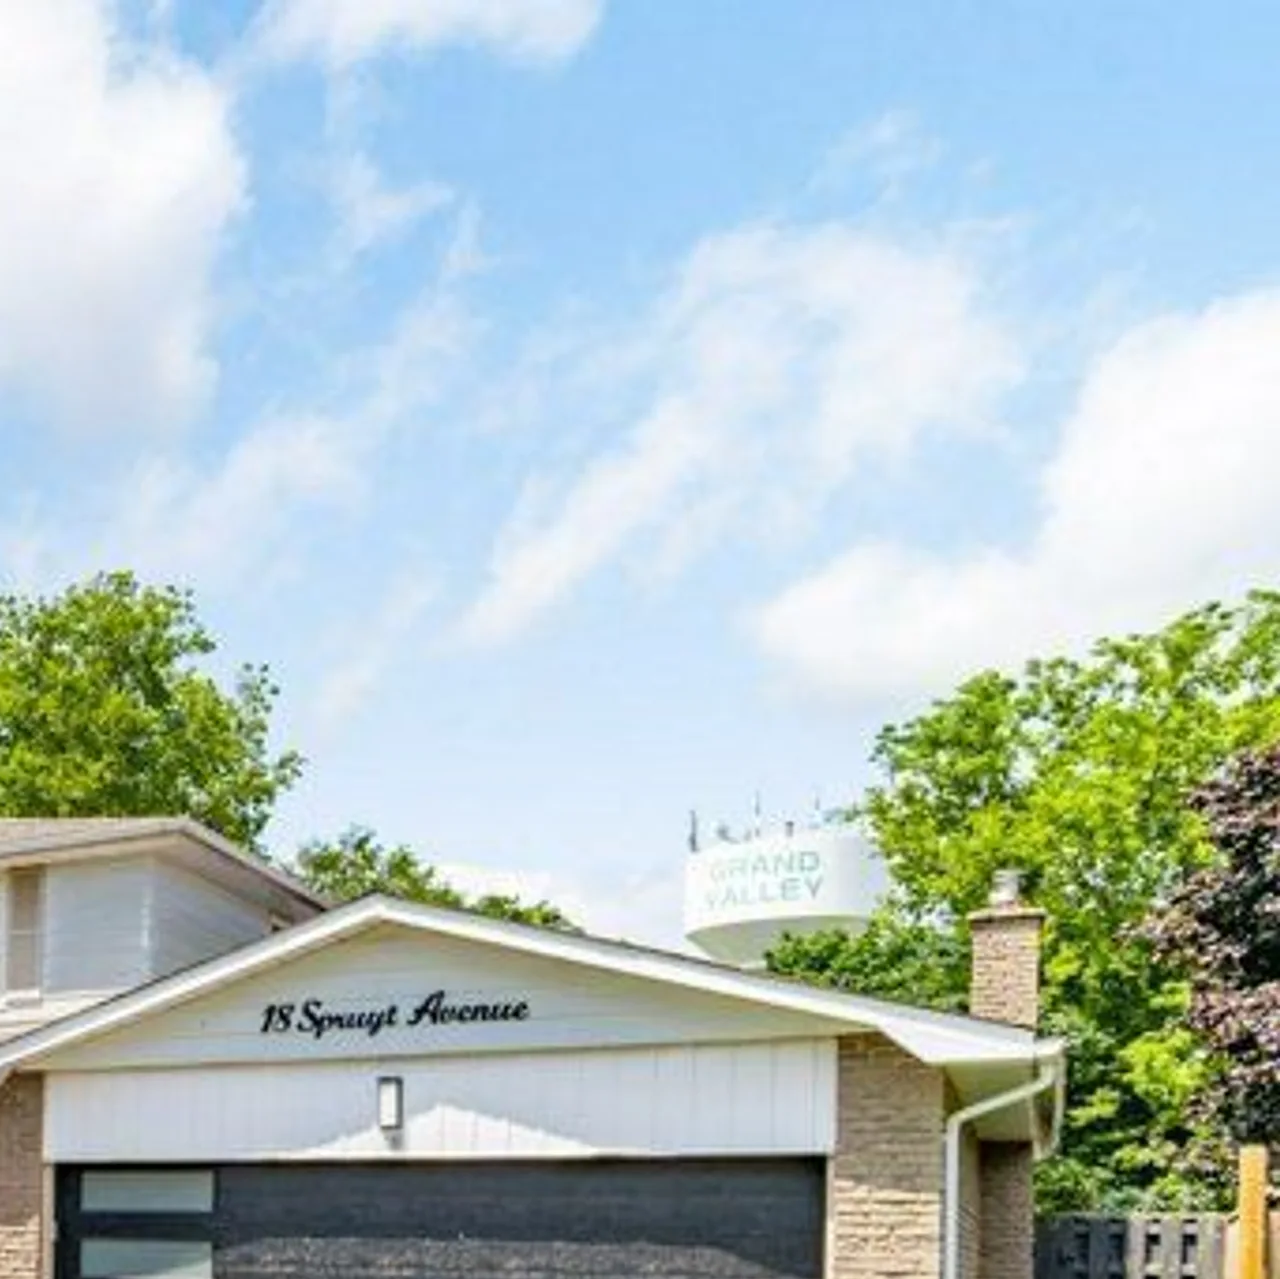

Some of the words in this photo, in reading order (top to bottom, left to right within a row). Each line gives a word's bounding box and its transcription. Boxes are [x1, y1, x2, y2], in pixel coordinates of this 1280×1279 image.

[710, 851, 821, 882] GRAND
[706, 876, 824, 910] VALLEY
[260, 1003, 294, 1033] 18
[296, 999, 399, 1039] Spruyt
[406, 989, 531, 1026] Avenue
